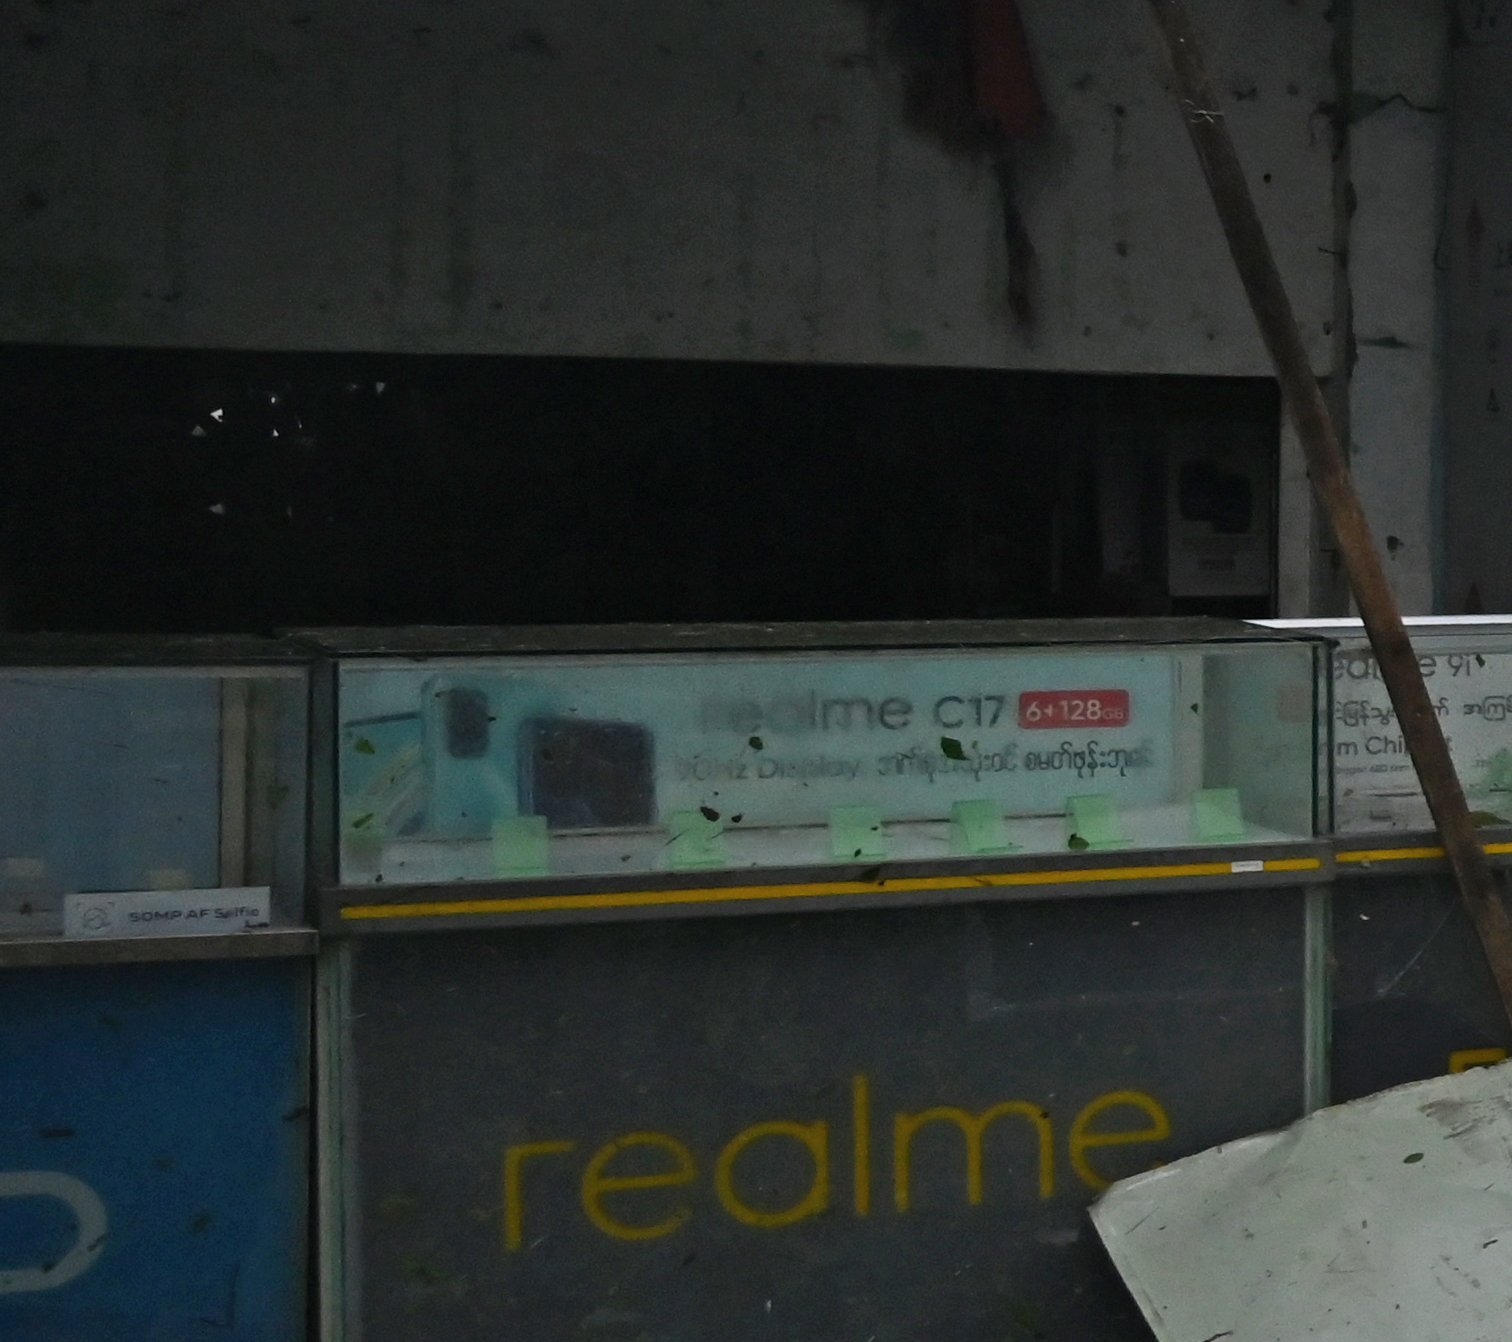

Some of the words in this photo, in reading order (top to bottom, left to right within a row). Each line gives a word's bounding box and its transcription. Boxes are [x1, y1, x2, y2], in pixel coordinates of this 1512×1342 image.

[700, 689, 913, 731] elme
[933, 693, 1006, 729] C17
[503, 1072, 1171, 1252] realme
